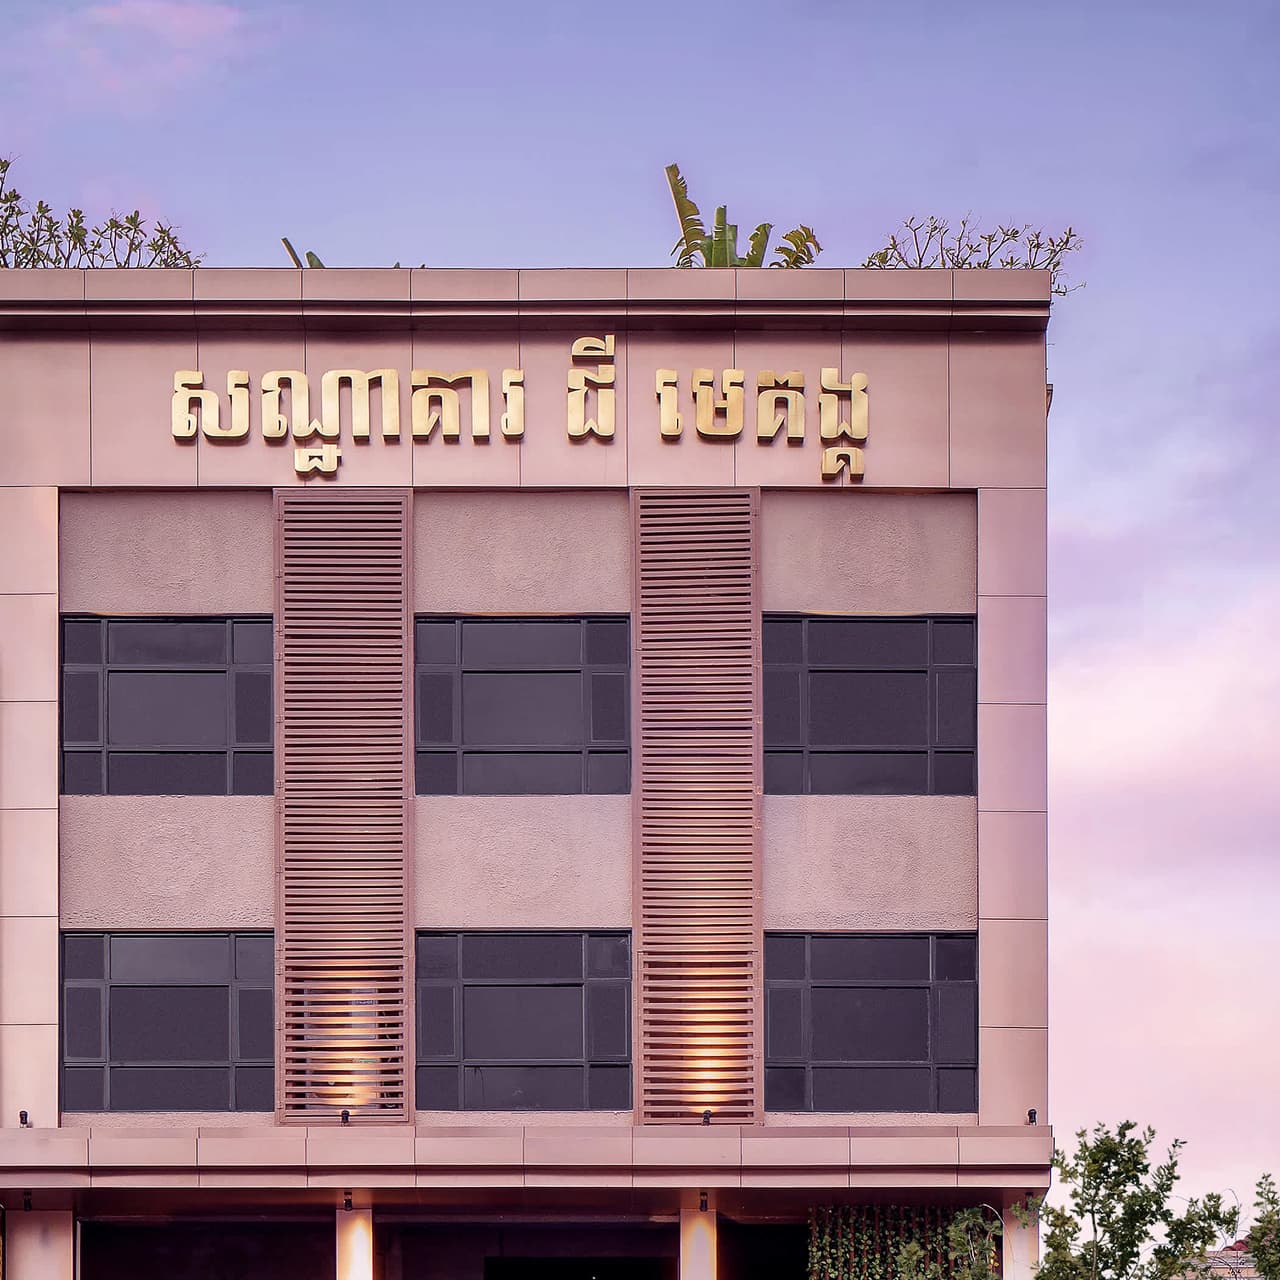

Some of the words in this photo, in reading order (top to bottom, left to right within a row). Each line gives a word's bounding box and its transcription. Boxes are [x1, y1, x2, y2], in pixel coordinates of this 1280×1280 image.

[171, 368, 524, 476] សណ្ឋាគារ
[655, 367, 870, 480] មេគង្គ
